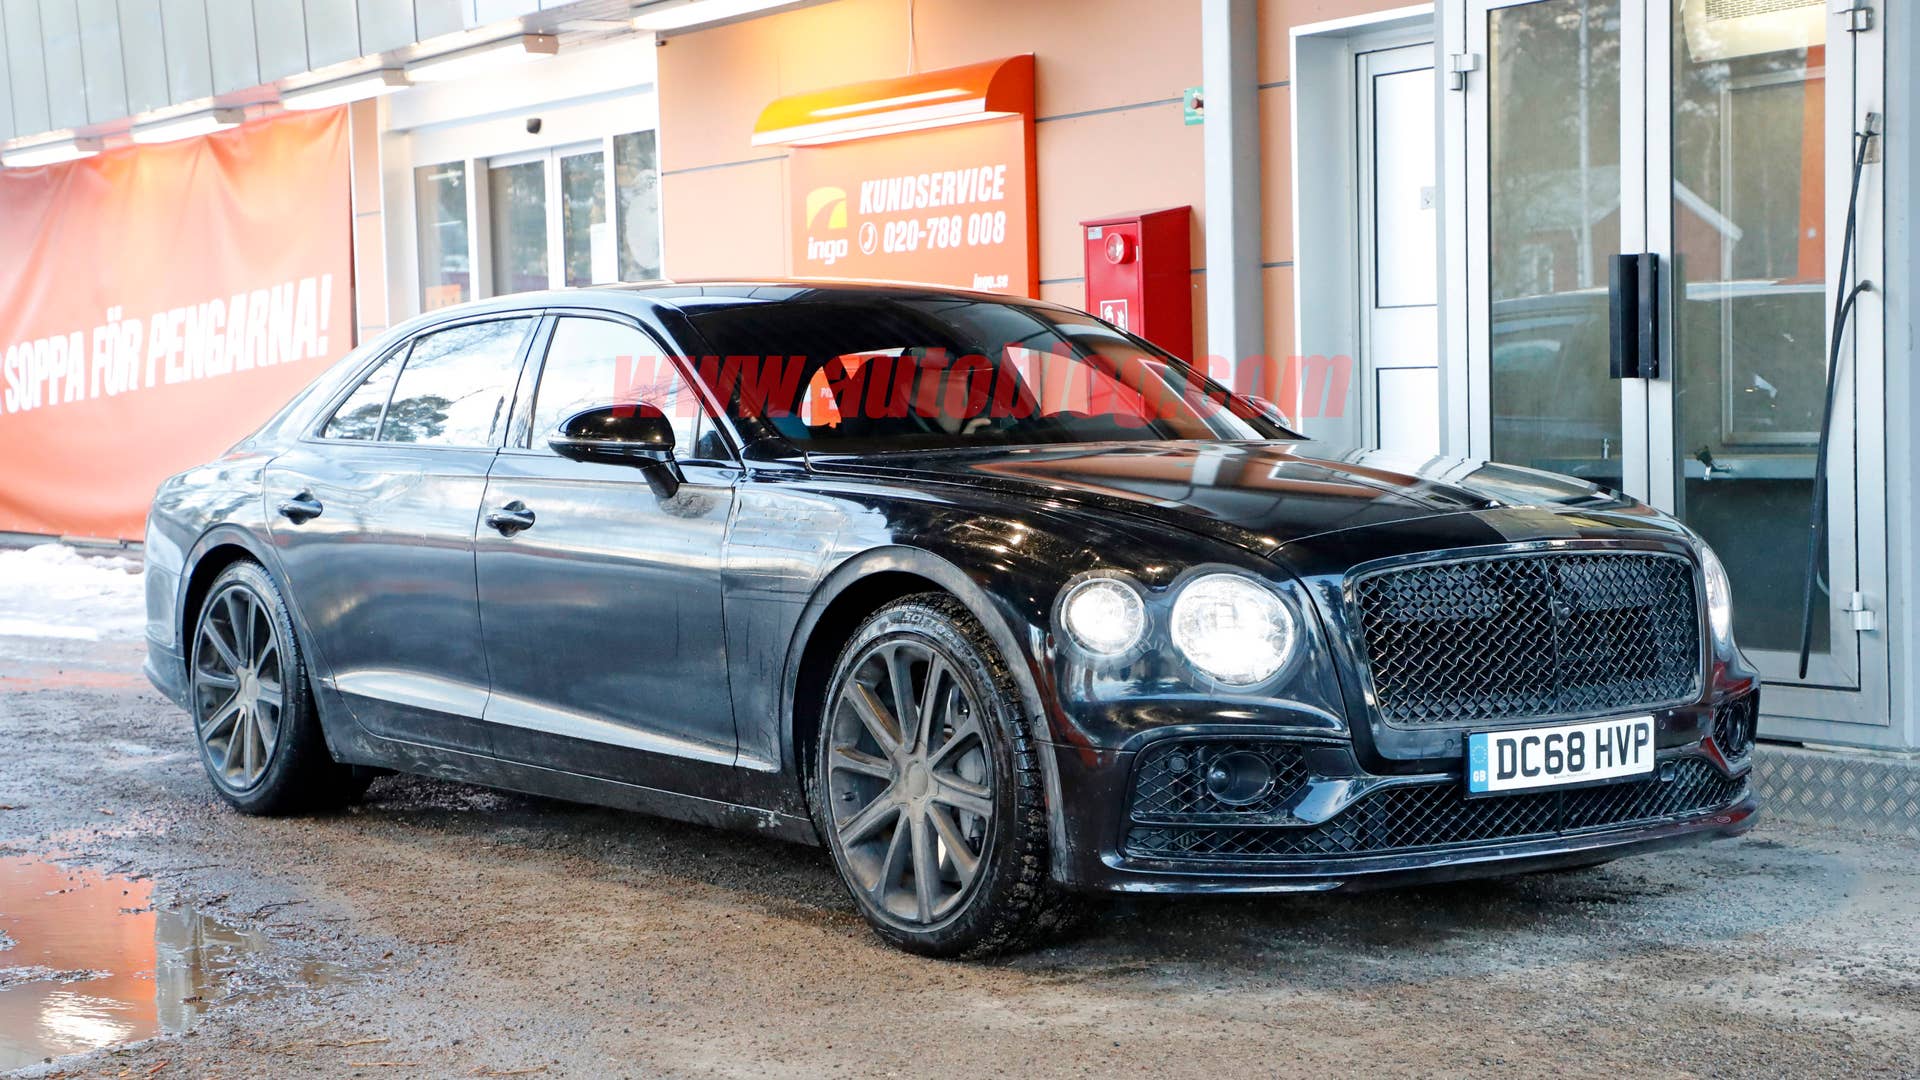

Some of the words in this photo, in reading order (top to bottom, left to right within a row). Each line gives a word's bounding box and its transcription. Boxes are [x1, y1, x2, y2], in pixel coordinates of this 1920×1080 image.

[859, 164, 1006, 215] KUNDSERVICE
[807, 236, 849, 265] ingo
[883, 215, 962, 254] 020-788
[968, 211, 1006, 245] 008
[4, 331, 85, 413] SOPPA
[90, 305, 143, 399] FÖR
[145, 273, 332, 388] PENGARNA!
[1497, 731, 1586, 781] DC68
[1595, 722, 1650, 769] HVP
[1472, 769, 1487, 783] GB
